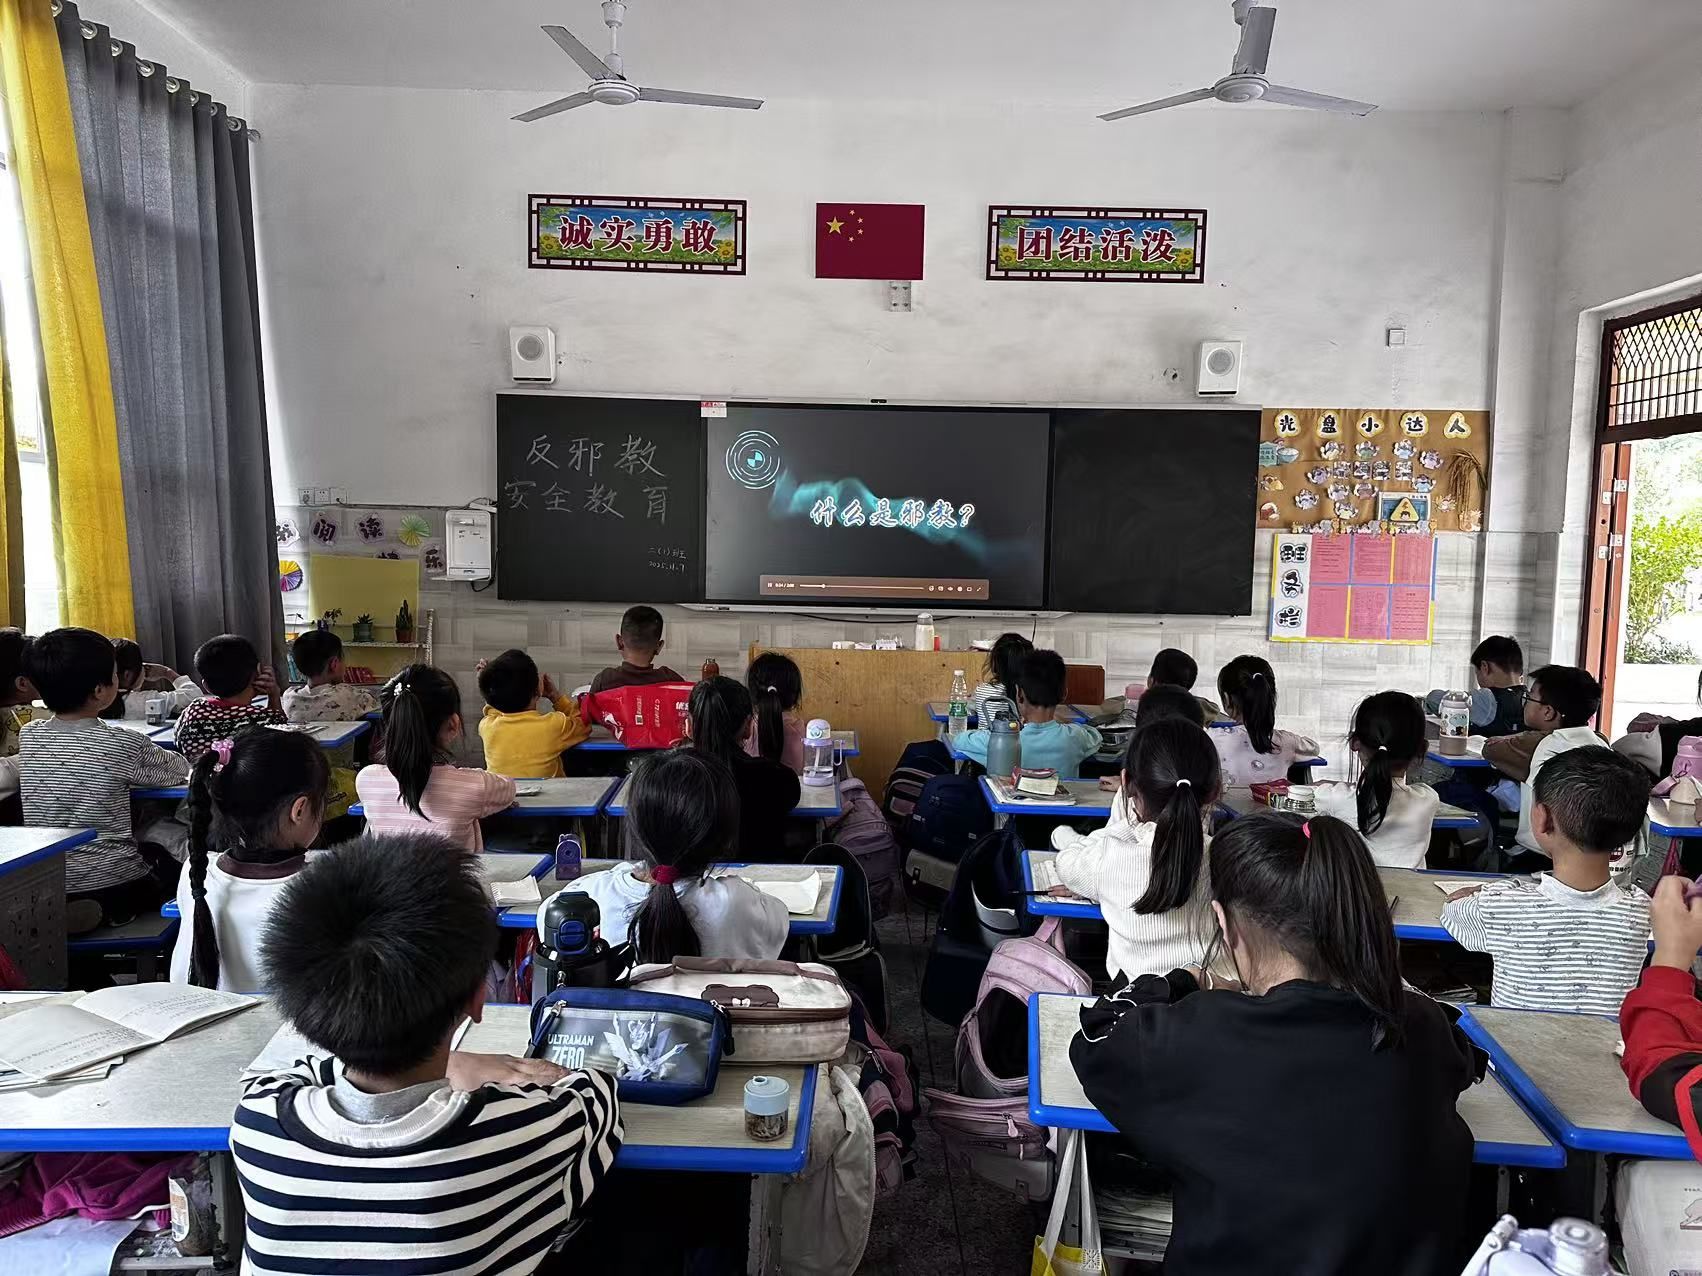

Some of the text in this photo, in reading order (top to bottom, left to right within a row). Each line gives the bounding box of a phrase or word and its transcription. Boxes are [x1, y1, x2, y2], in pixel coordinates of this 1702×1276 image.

[558, 213, 718, 256] 诚实勇敢
[1015, 225, 1178, 264] 团结活泼
[1279, 413, 1467, 434] 光盘小达人
[526, 434, 667, 477] 反邪教
[504, 480, 668, 525] 安全教育
[809, 497, 976, 528] 什么是邪教?
[547, 1033, 595, 1046] ULTRAMAN
